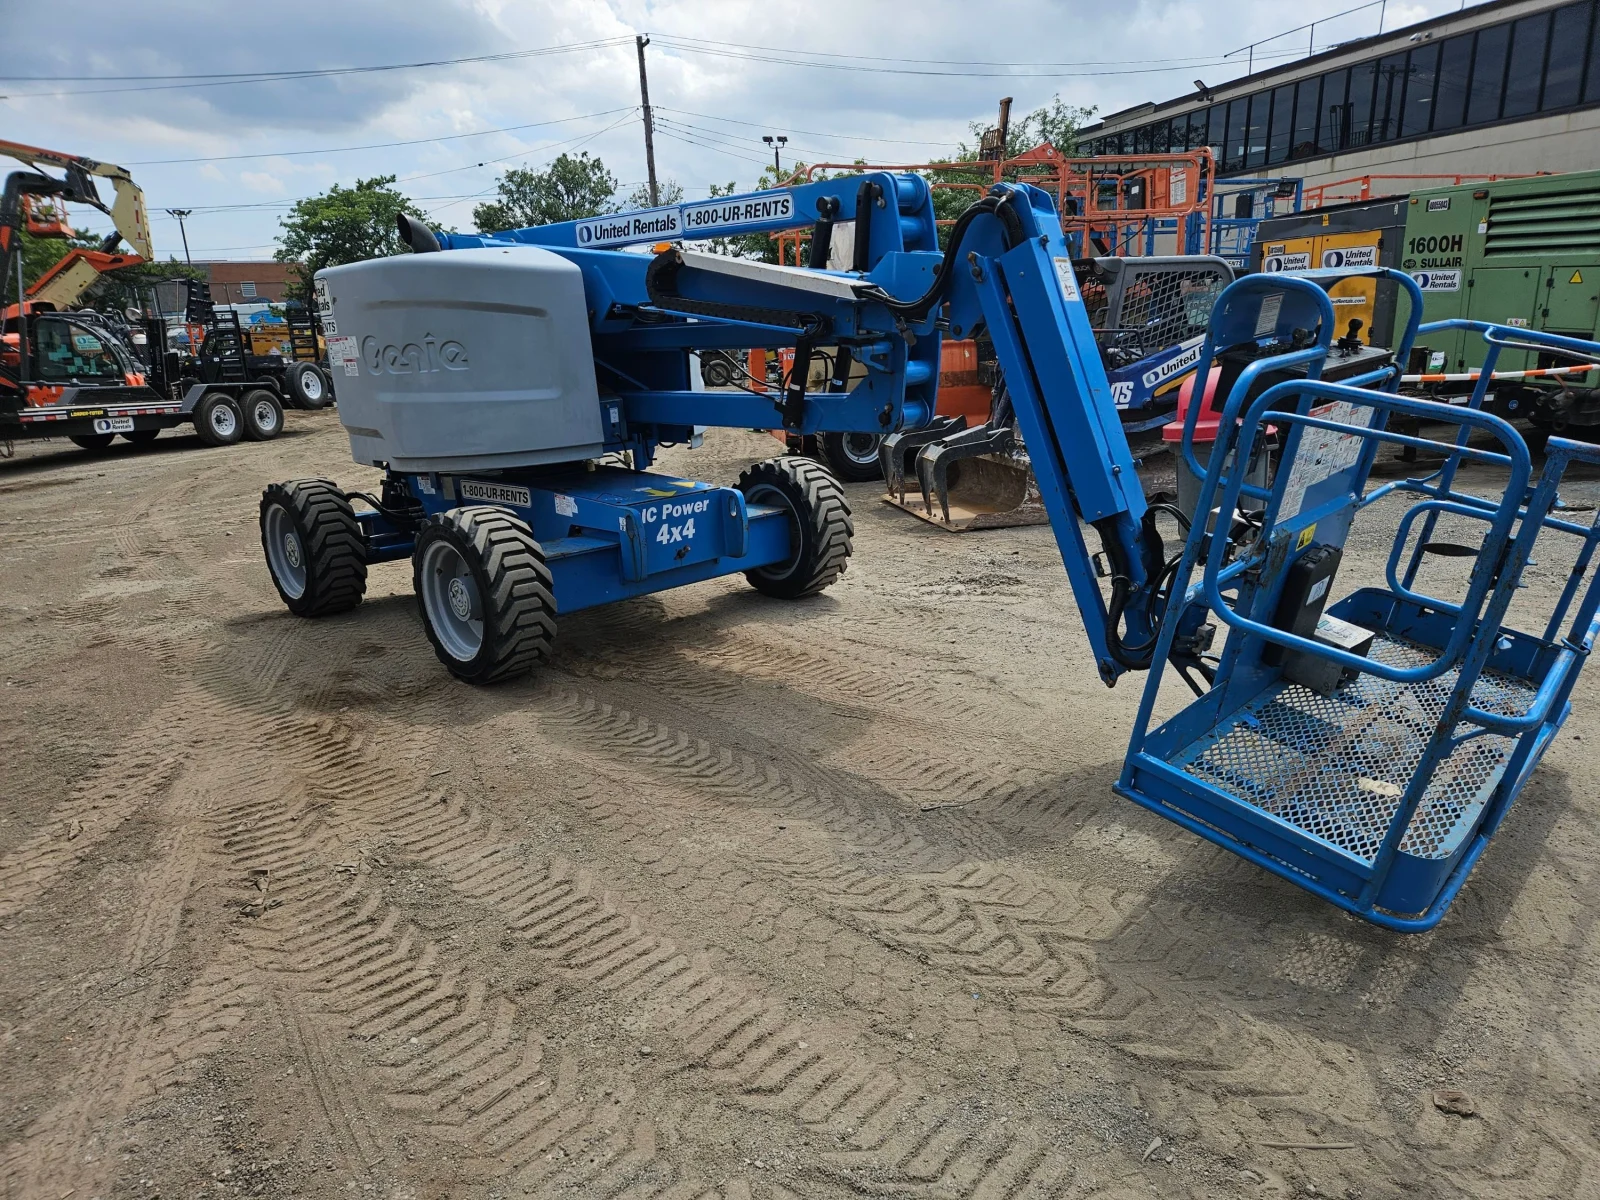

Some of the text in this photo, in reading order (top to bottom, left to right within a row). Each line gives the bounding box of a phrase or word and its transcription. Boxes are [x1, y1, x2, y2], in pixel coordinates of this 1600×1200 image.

[686, 198, 790, 226] 1-800-UR-RENTS
[594, 214, 676, 240] United Rentals
[1408, 234, 1463, 254] 1600H
[1283, 255, 1306, 265] United
[1345, 249, 1373, 259] United
[1344, 258, 1373, 267] Rentals
[1420, 257, 1462, 268] SULLAIR
[1429, 281, 1457, 289] Rentals
[1431, 273, 1457, 281] United
[316, 284, 325, 297] ed
[320, 298, 331, 311] als
[362, 332, 469, 376] Genie
[1161, 350, 1197, 376] United
[462, 484, 529, 504] 1-800-UR-RENTS
[641, 506, 658, 524] IC
[662, 499, 710, 520] Power
[656, 517, 696, 545] 4x4
